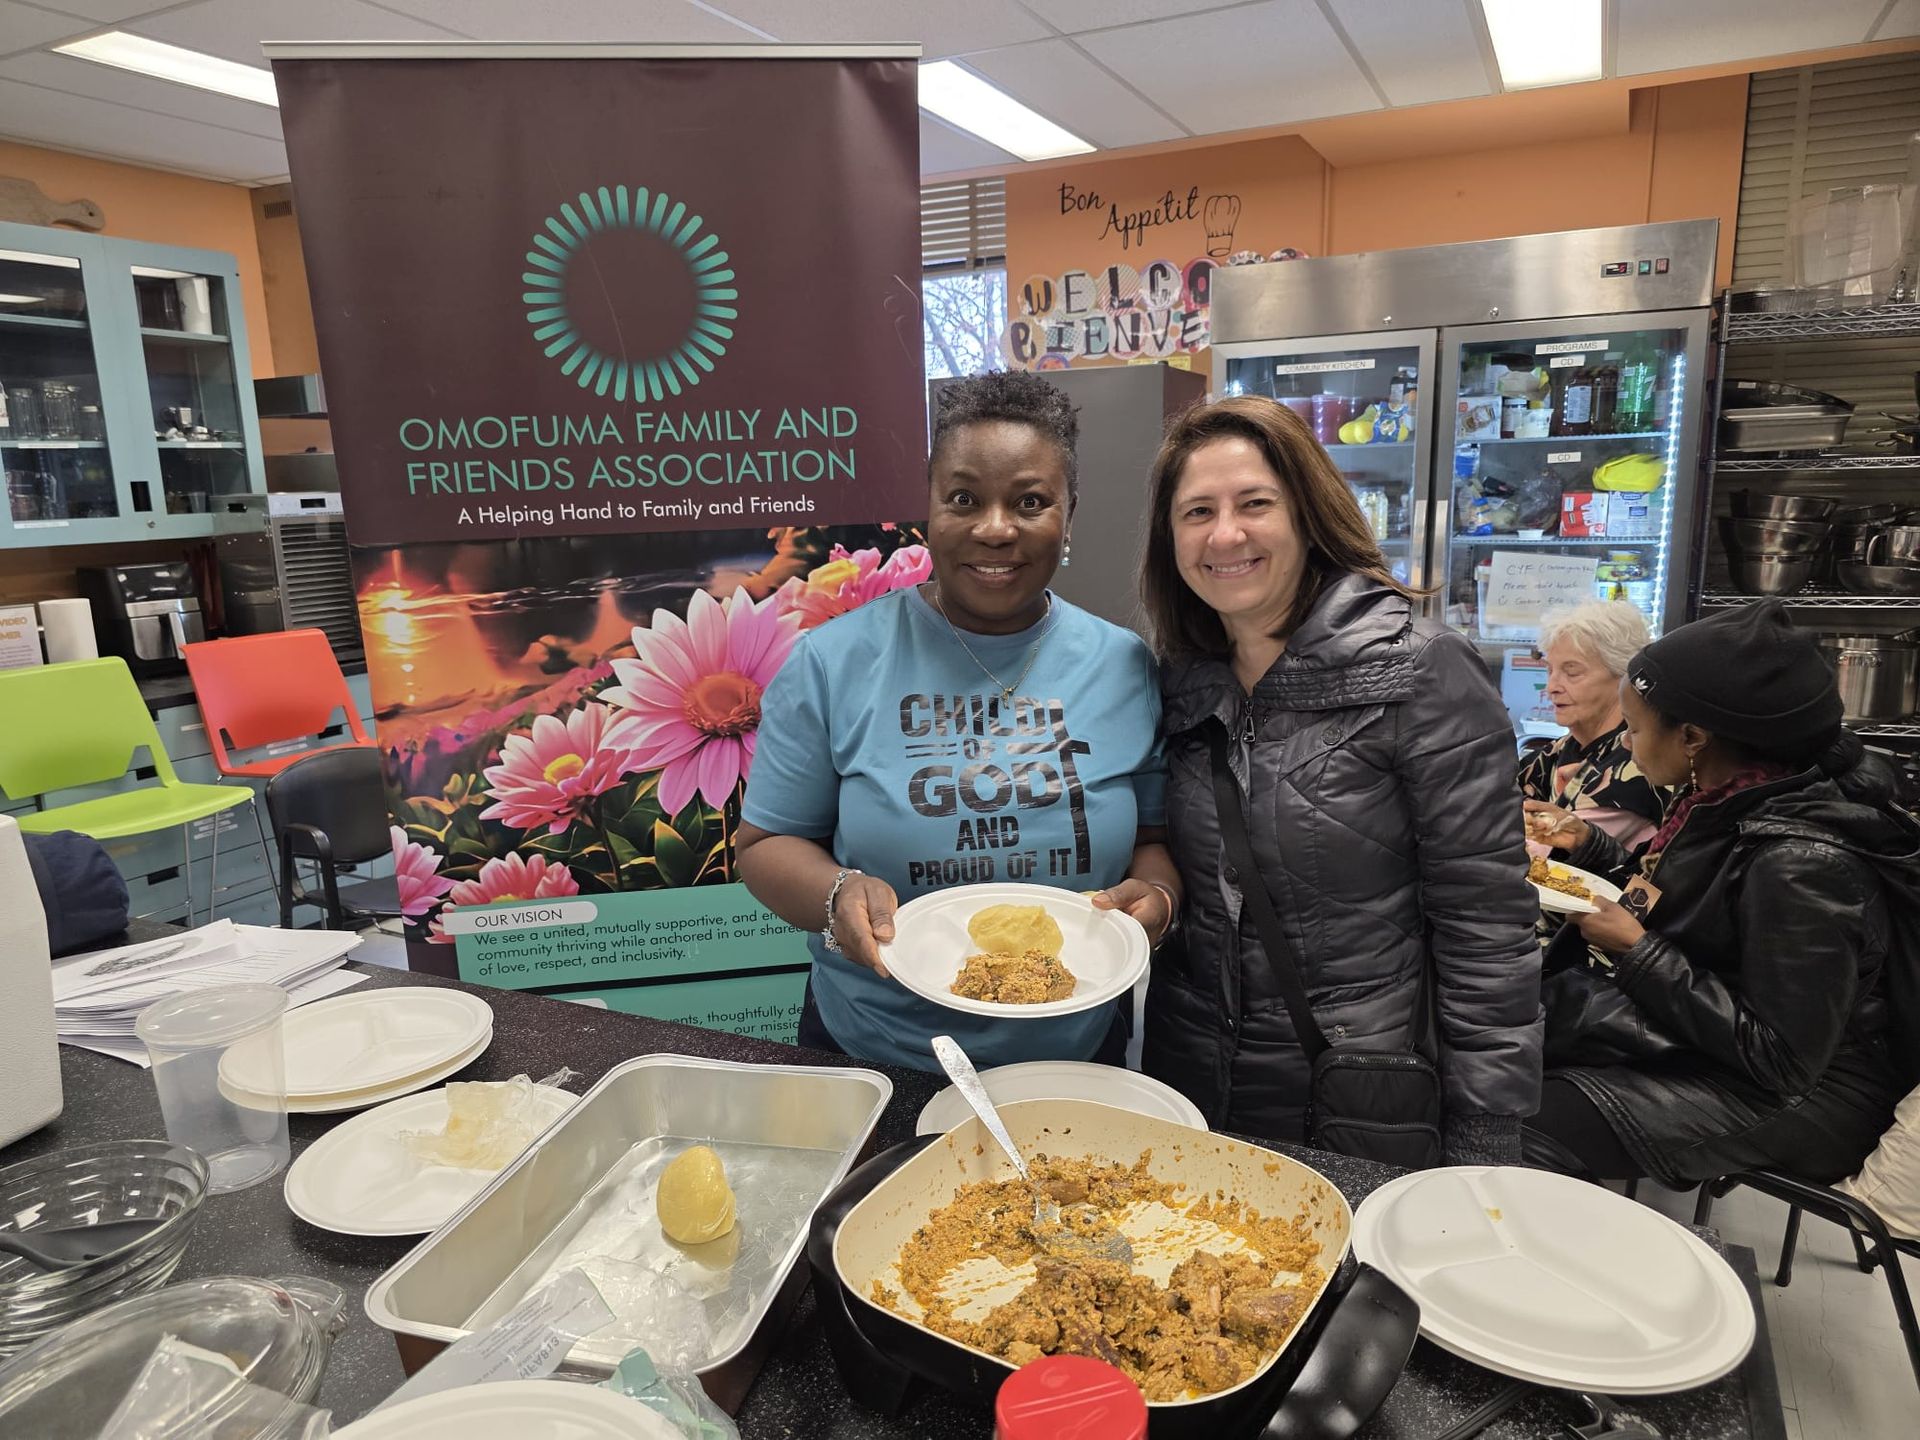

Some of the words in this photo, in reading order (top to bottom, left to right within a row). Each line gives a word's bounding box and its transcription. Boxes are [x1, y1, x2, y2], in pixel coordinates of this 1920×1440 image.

[1057, 182, 1105, 216] Bon
[1024, 261, 1211, 316] WELCO
[1010, 310, 1203, 363] BIENVE
[1546, 341, 1598, 352] PROGRAMS
[1284, 363, 1331, 374] COMMUNITY
[1332, 360, 1366, 370] KITCHEN
[1560, 358, 1574, 366] CD
[399, 413, 625, 451] OMOFUMA
[635, 408, 762, 444] FAMILY
[774, 406, 858, 440] AND
[406, 457, 576, 496] FRIENDS
[587, 448, 856, 489] ASSOCIATION
[1557, 453, 1571, 462] CD
[457, 507, 474, 525] A
[478, 504, 554, 527] Helping
[560, 500, 612, 521] Hand
[617, 502, 637, 519] to
[642, 497, 703, 520] Family
[708, 495, 744, 516] and
[750, 493, 816, 514] Friends
[899, 693, 1048, 738] CHILD
[963, 738, 997, 761] OF
[908, 761, 1064, 818] GOD
[955, 815, 1021, 852] AND
[908, 854, 995, 887] PROUD
[1006, 850, 1038, 880] OF
[1049, 847, 1073, 877] IT
[474, 914, 509, 929] OUR
[511, 908, 563, 925] VISION
[474, 934, 498, 946] We
[502, 933, 525, 944] see
[529, 931, 539, 941] a
[543, 924, 590, 940] united,
[594, 919, 652, 935] mutually
[655, 914, 728, 932] supportive,
[732, 909, 758, 923] and
[761, 912, 778, 921] en
[477, 943, 553, 962] community
[556, 939, 607, 954] thriving
[611, 935, 646, 949] while
[650, 929, 713, 946] anchored
[717, 929, 730, 940] in
[733, 928, 756, 938] our
[479, 964, 494, 977] of
[497, 962, 531, 975] love,
[535, 955, 588, 972] respect,
[591, 951, 617, 966] and
[621, 946, 687, 963] inclusivity.
[671, 1014, 703, 1026] ents,
[707, 1004, 784, 1023] thoughtfully
[787, 1003, 803, 1016] de
[734, 1025, 756, 1035] our
[760, 1018, 800, 1032] missio
[781, 1035, 798, 1044] an
